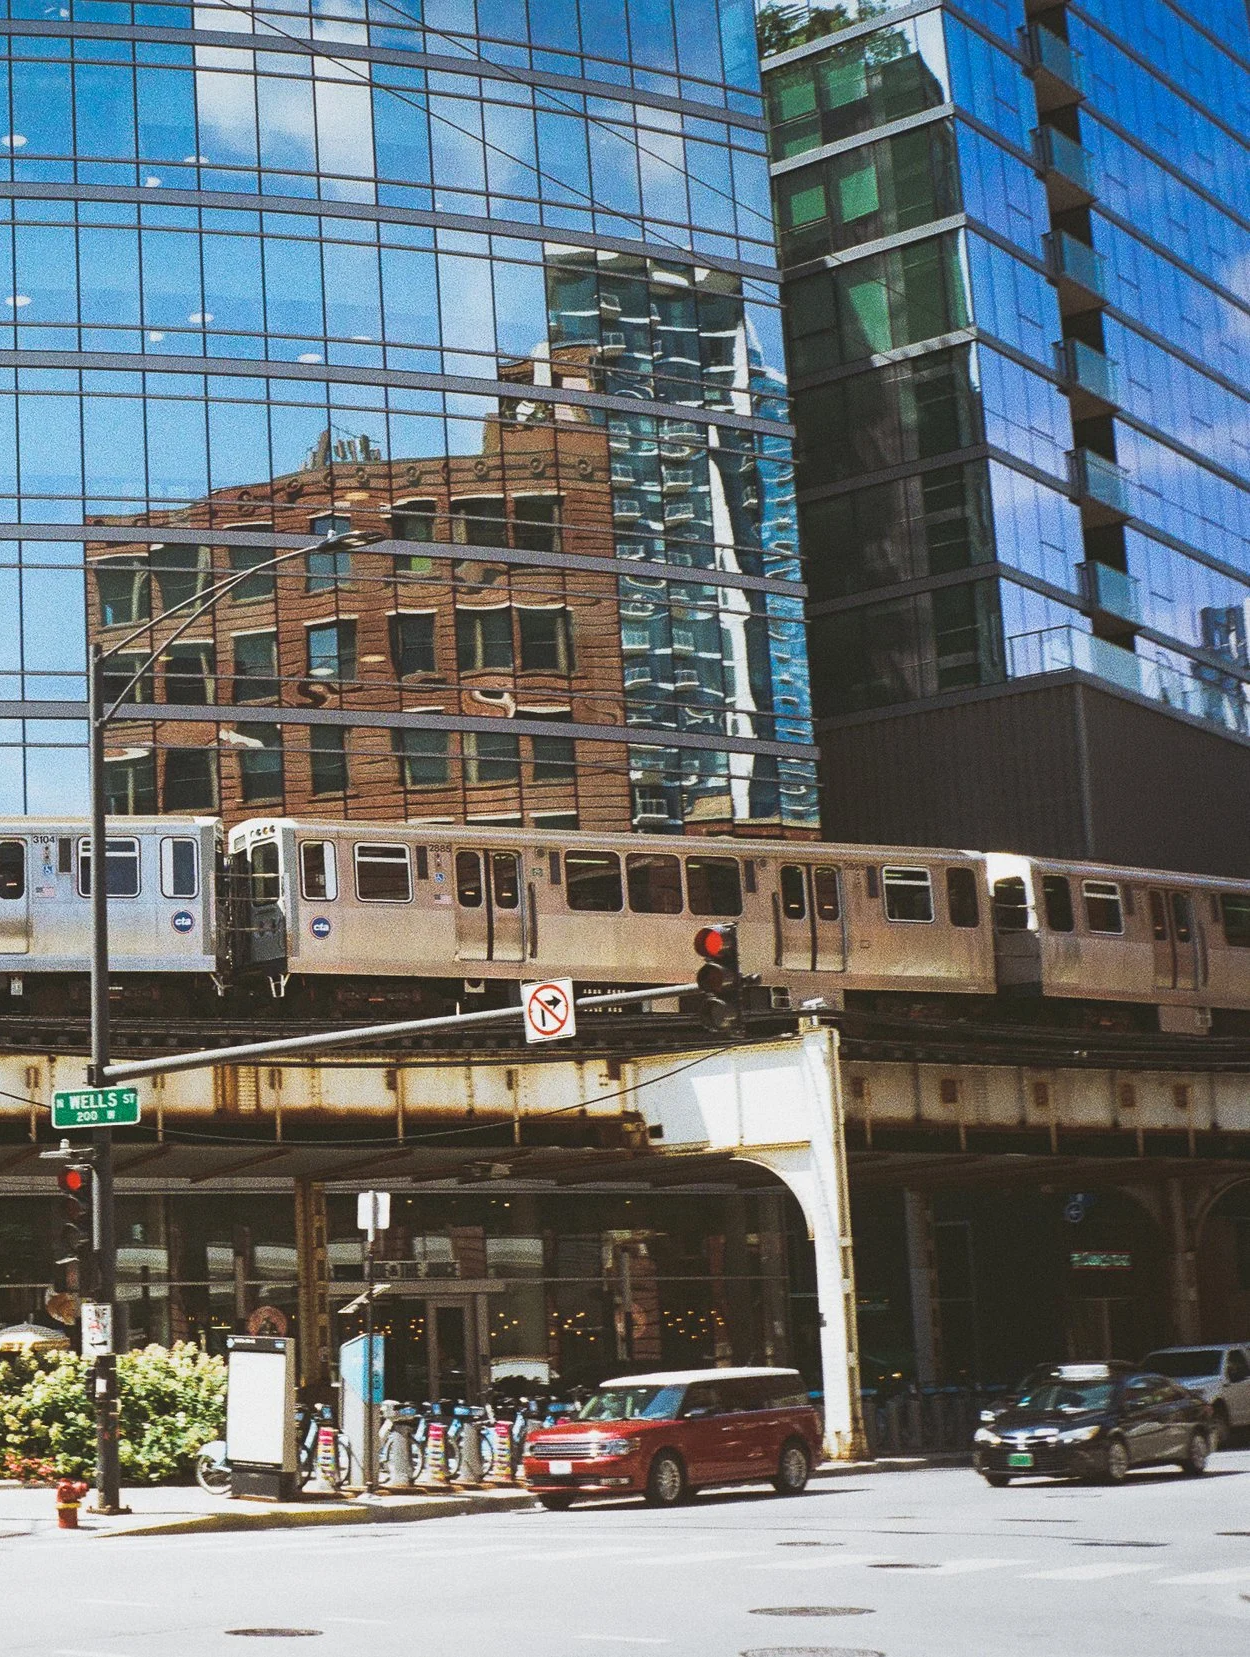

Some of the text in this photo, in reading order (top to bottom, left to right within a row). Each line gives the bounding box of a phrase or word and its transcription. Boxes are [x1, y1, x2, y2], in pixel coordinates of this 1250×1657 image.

[429, 844, 451, 852] 2885
[174, 917, 191, 926] cta
[70, 1093, 117, 1109] WELLS
[122, 1093, 135, 1104] ST
[76, 1111, 98, 1121] 200
